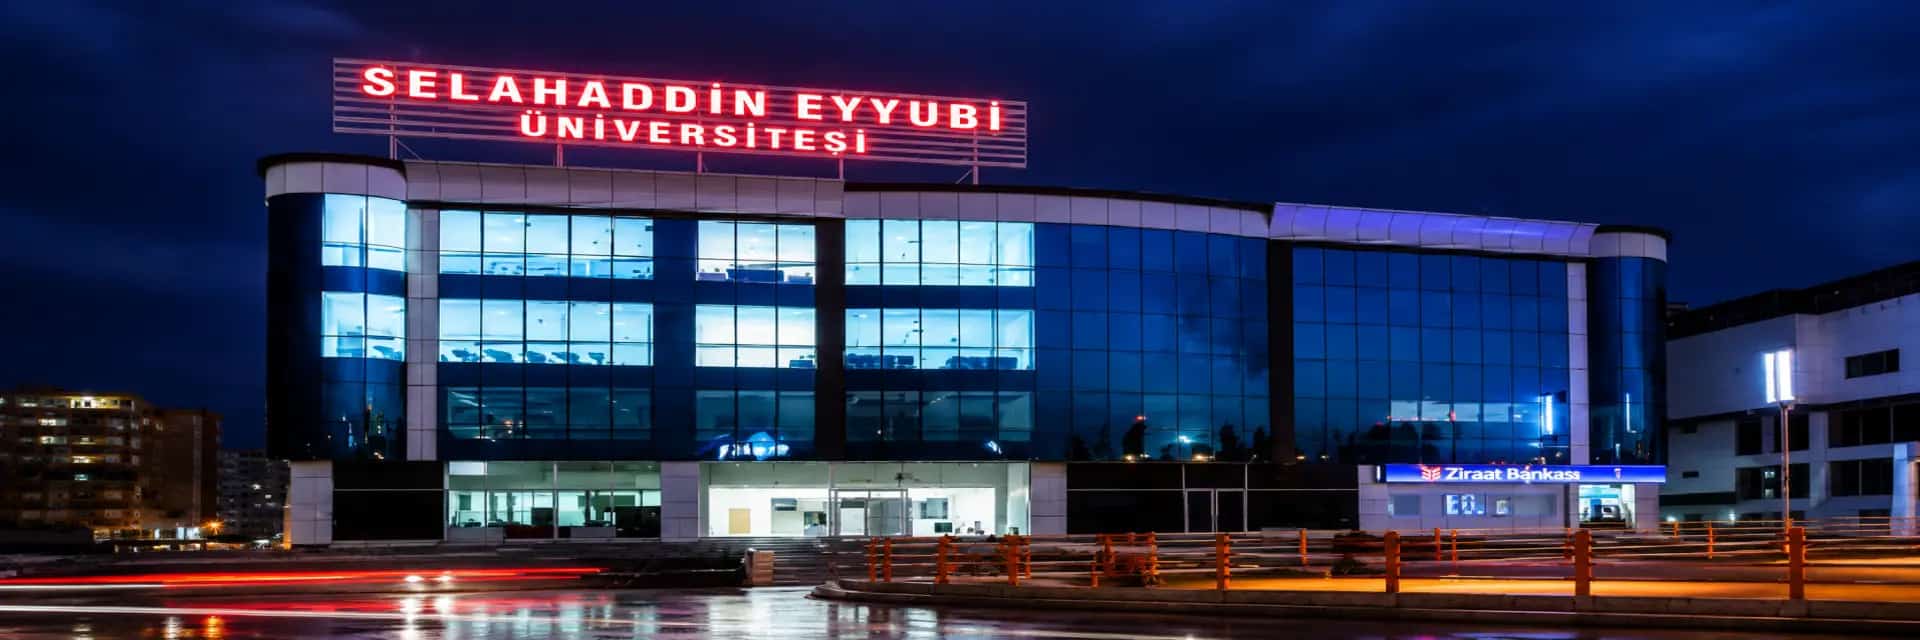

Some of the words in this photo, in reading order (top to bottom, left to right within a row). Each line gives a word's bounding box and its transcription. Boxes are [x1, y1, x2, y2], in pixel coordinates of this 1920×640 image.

[362, 66, 766, 117] SELAHADDİN
[796, 92, 1001, 132] EYYUBİ
[520, 108, 865, 156] ÜNİVERSİTEŞİ
[1445, 467, 1503, 481] Ziraat
